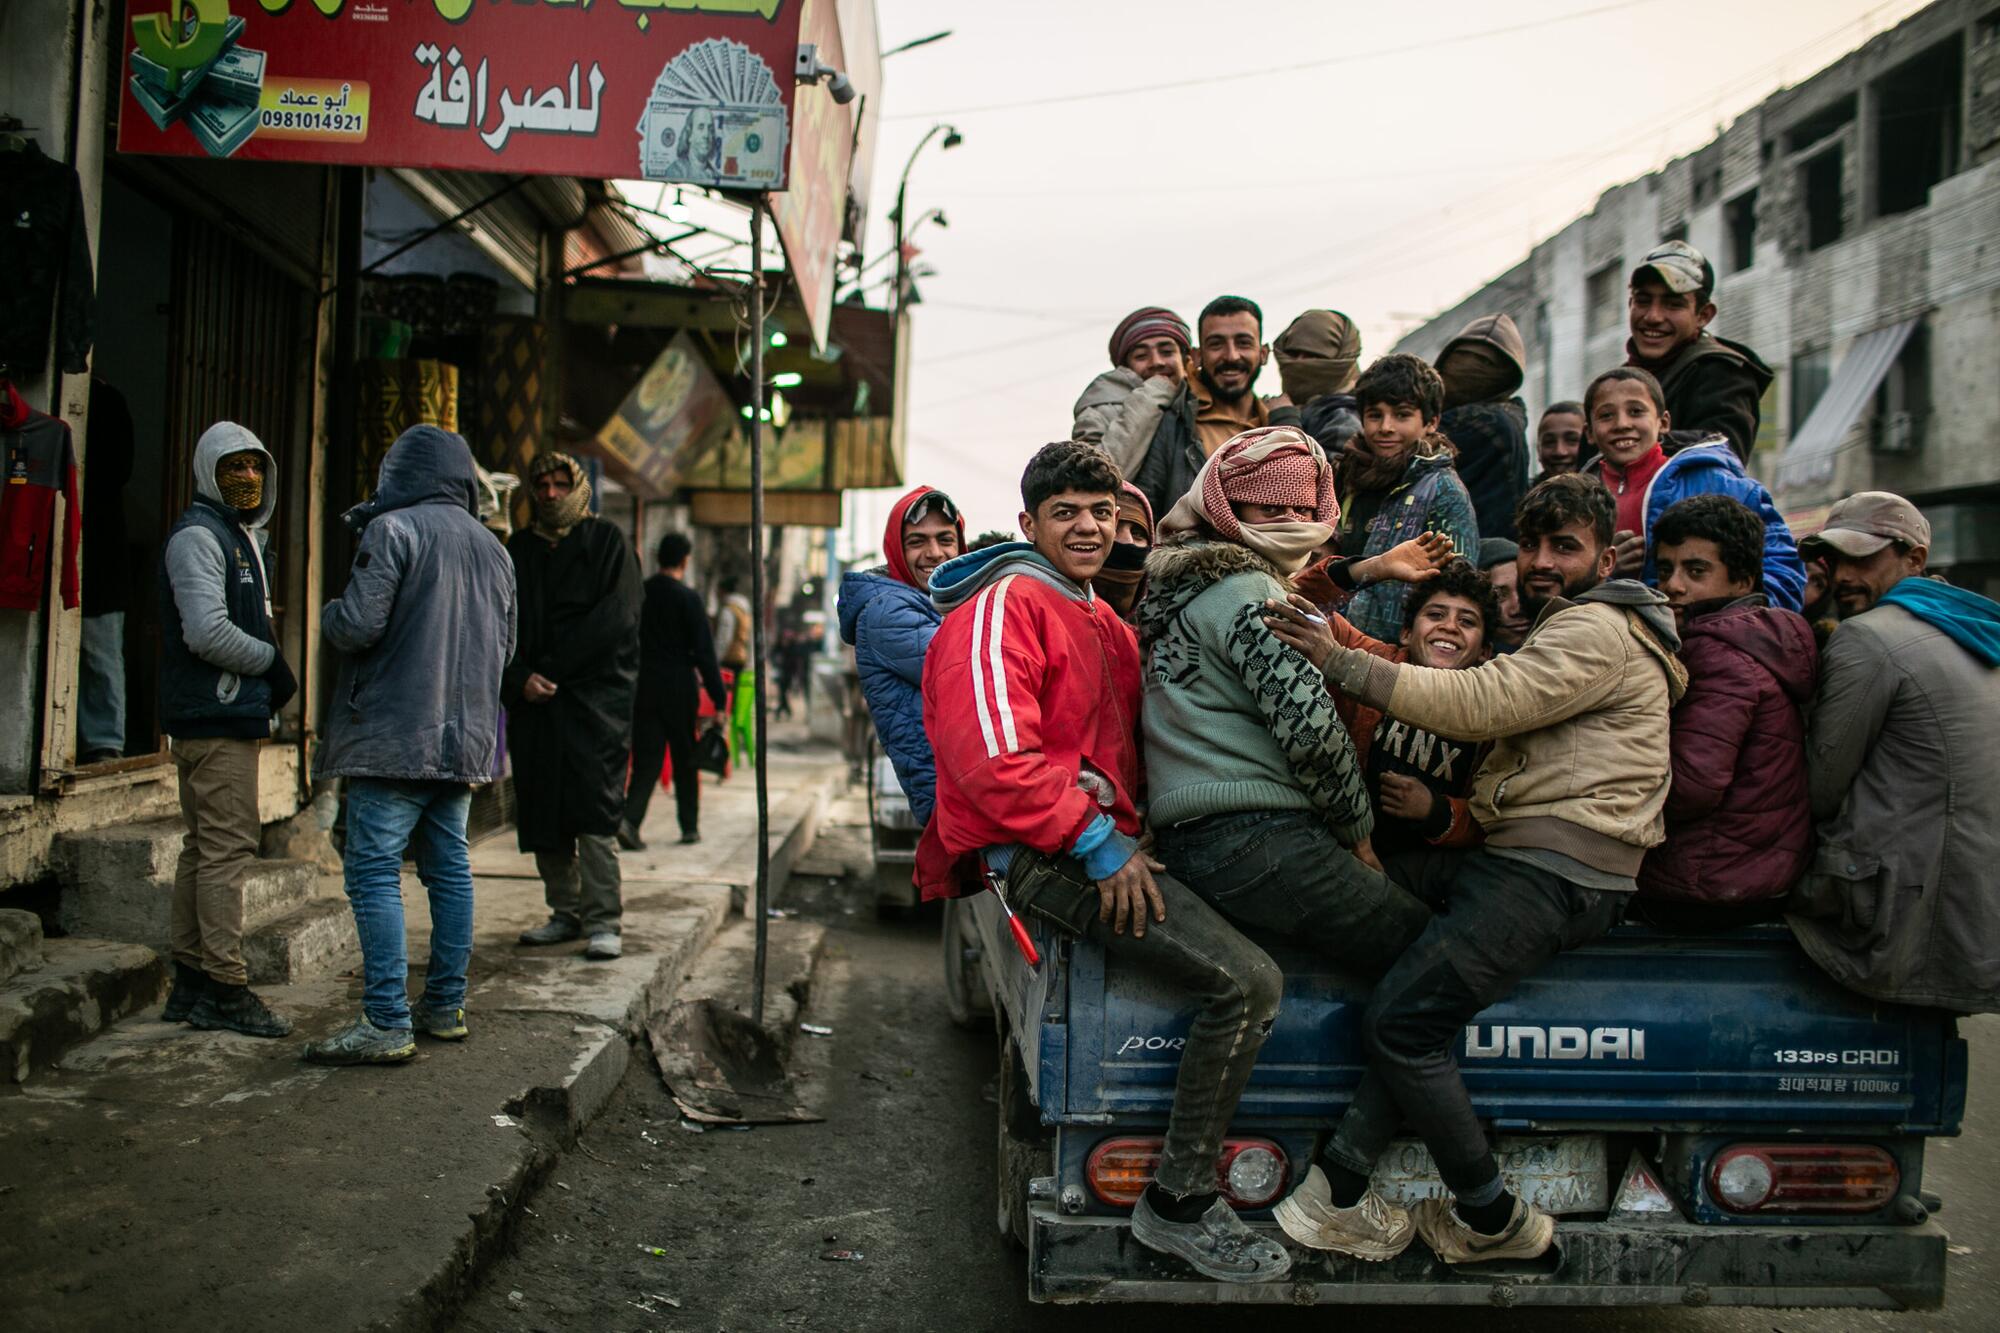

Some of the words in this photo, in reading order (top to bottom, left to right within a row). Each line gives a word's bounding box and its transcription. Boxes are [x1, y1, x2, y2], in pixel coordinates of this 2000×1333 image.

[280, 90, 318, 106] عماد
[324, 83, 349, 112] أبو
[414, 43, 605, 150] للصرافة
[262, 110, 362, 131] 0981014921
[1374, 717, 1462, 781] RNX
[1465, 1025, 1645, 1060] UNDAI
[1841, 1050, 1899, 1065] CRDi
[1778, 1078, 1847, 1092] 최대적재량
